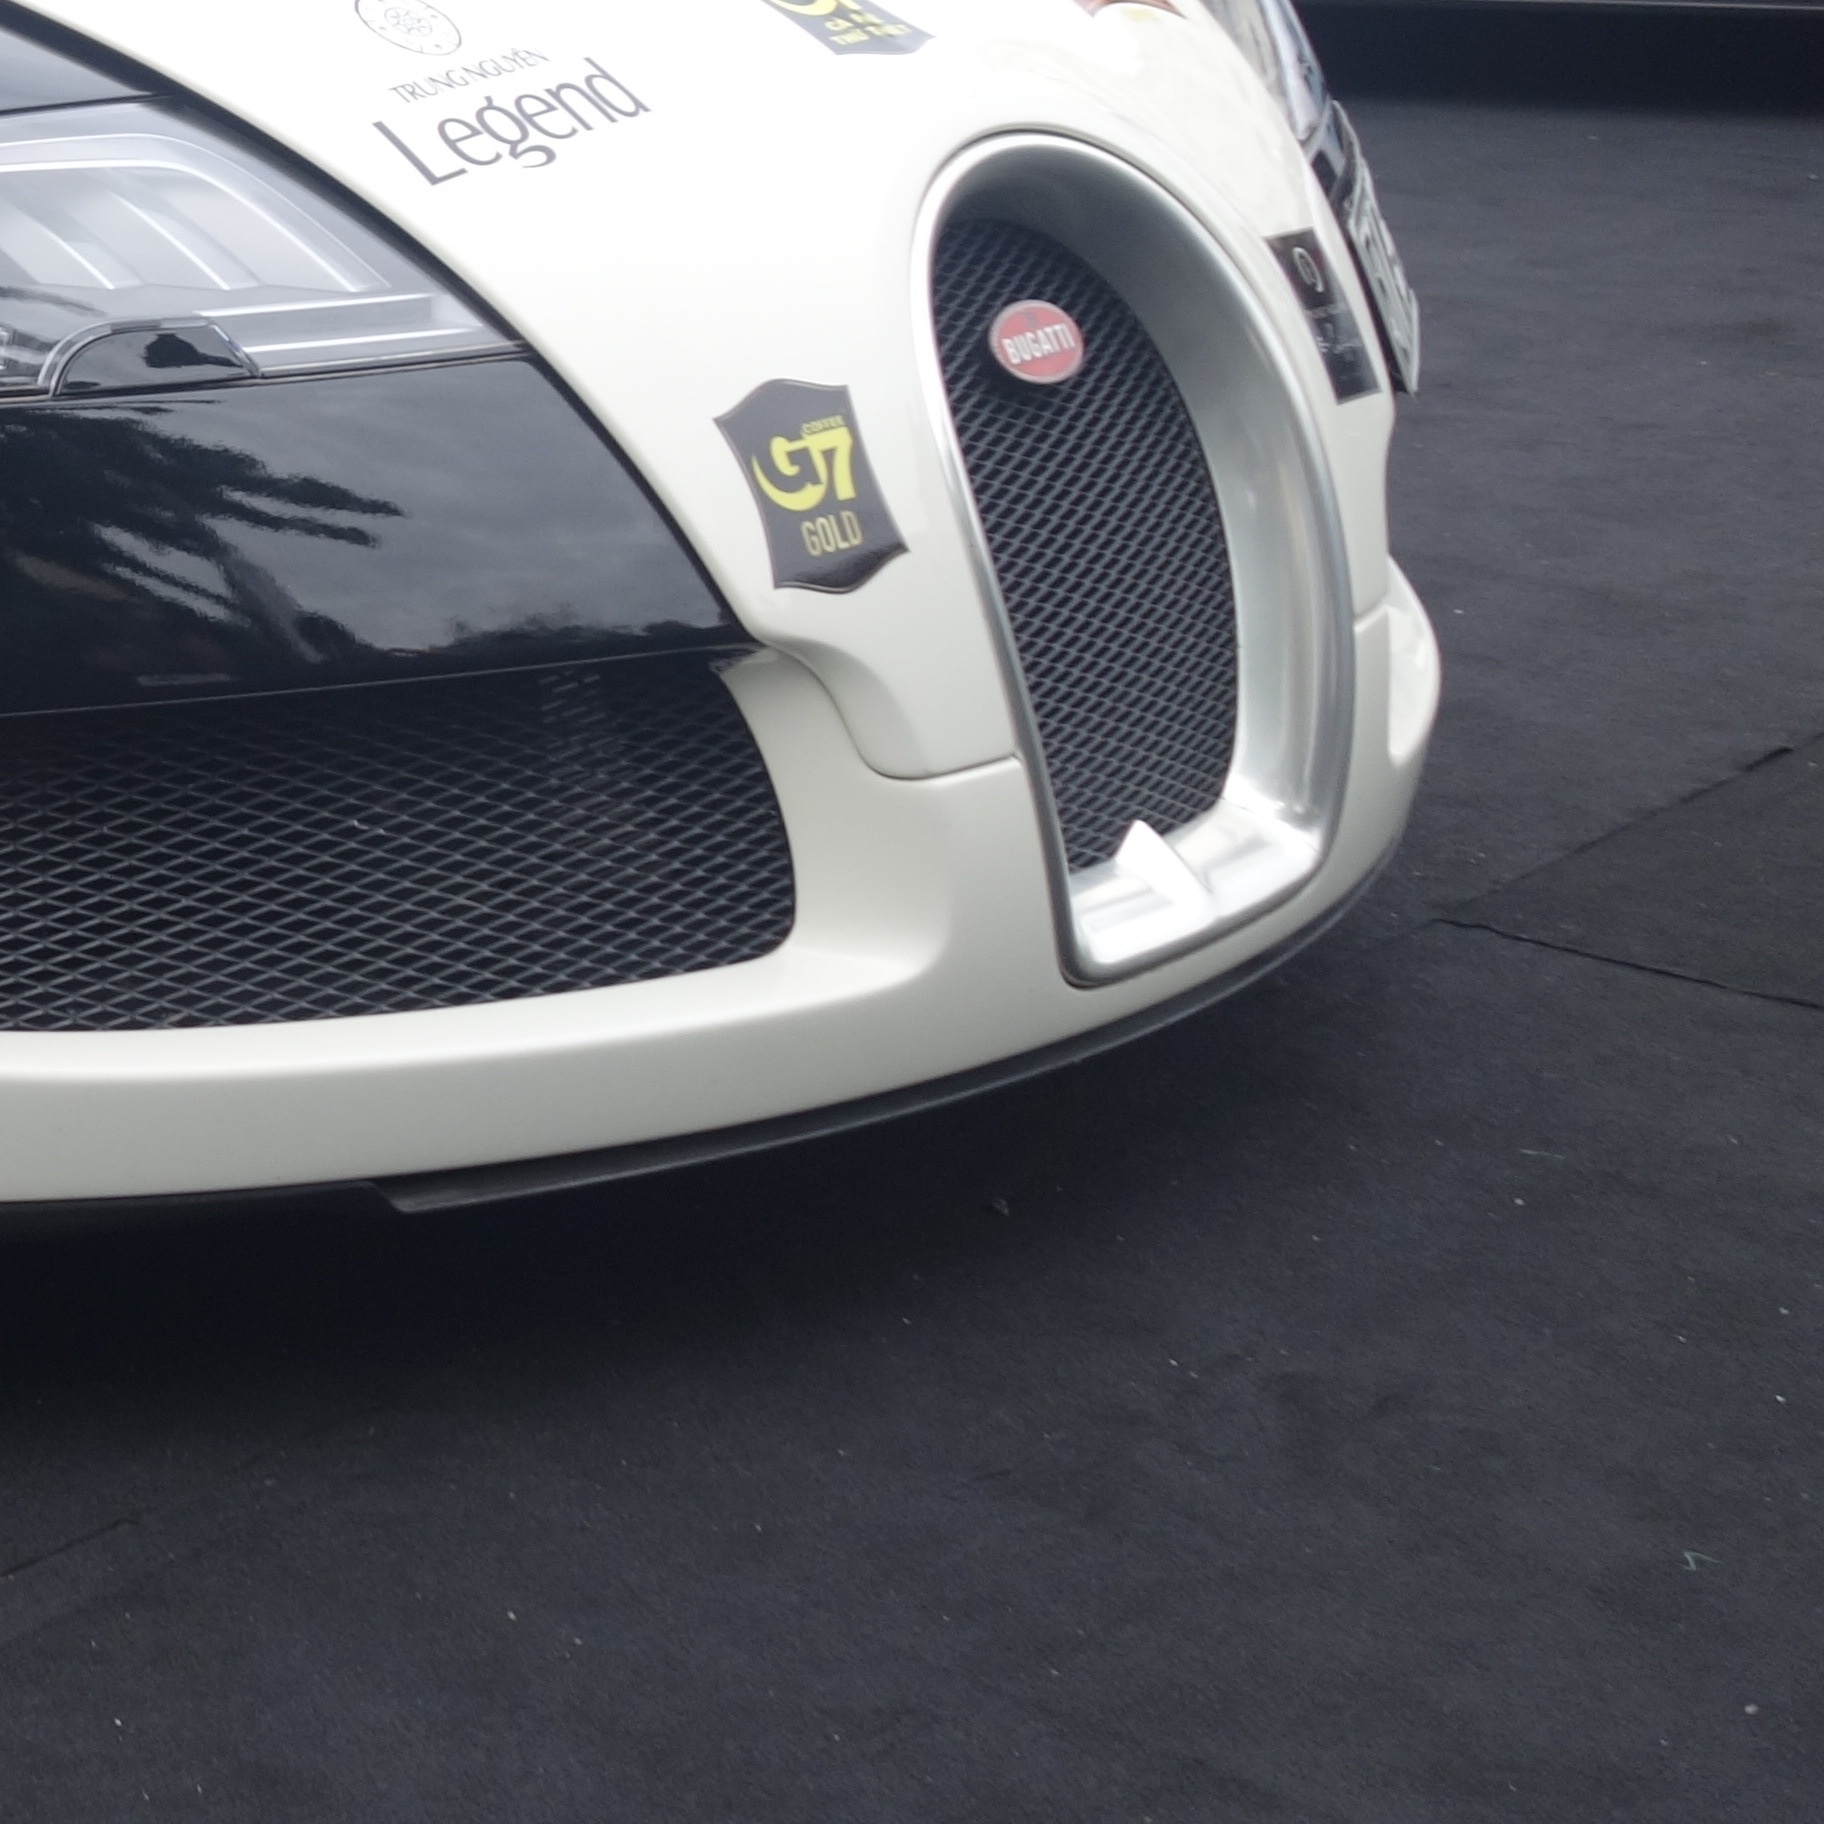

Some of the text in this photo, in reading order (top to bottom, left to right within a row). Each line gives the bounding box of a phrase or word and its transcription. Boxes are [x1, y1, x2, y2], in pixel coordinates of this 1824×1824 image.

[388, 69, 470, 103] TRUNG
[371, 56, 652, 187] Legend
[1002, 323, 1076, 365] BUGATTI
[752, 425, 856, 511] G7
[801, 509, 864, 558] GOLD
